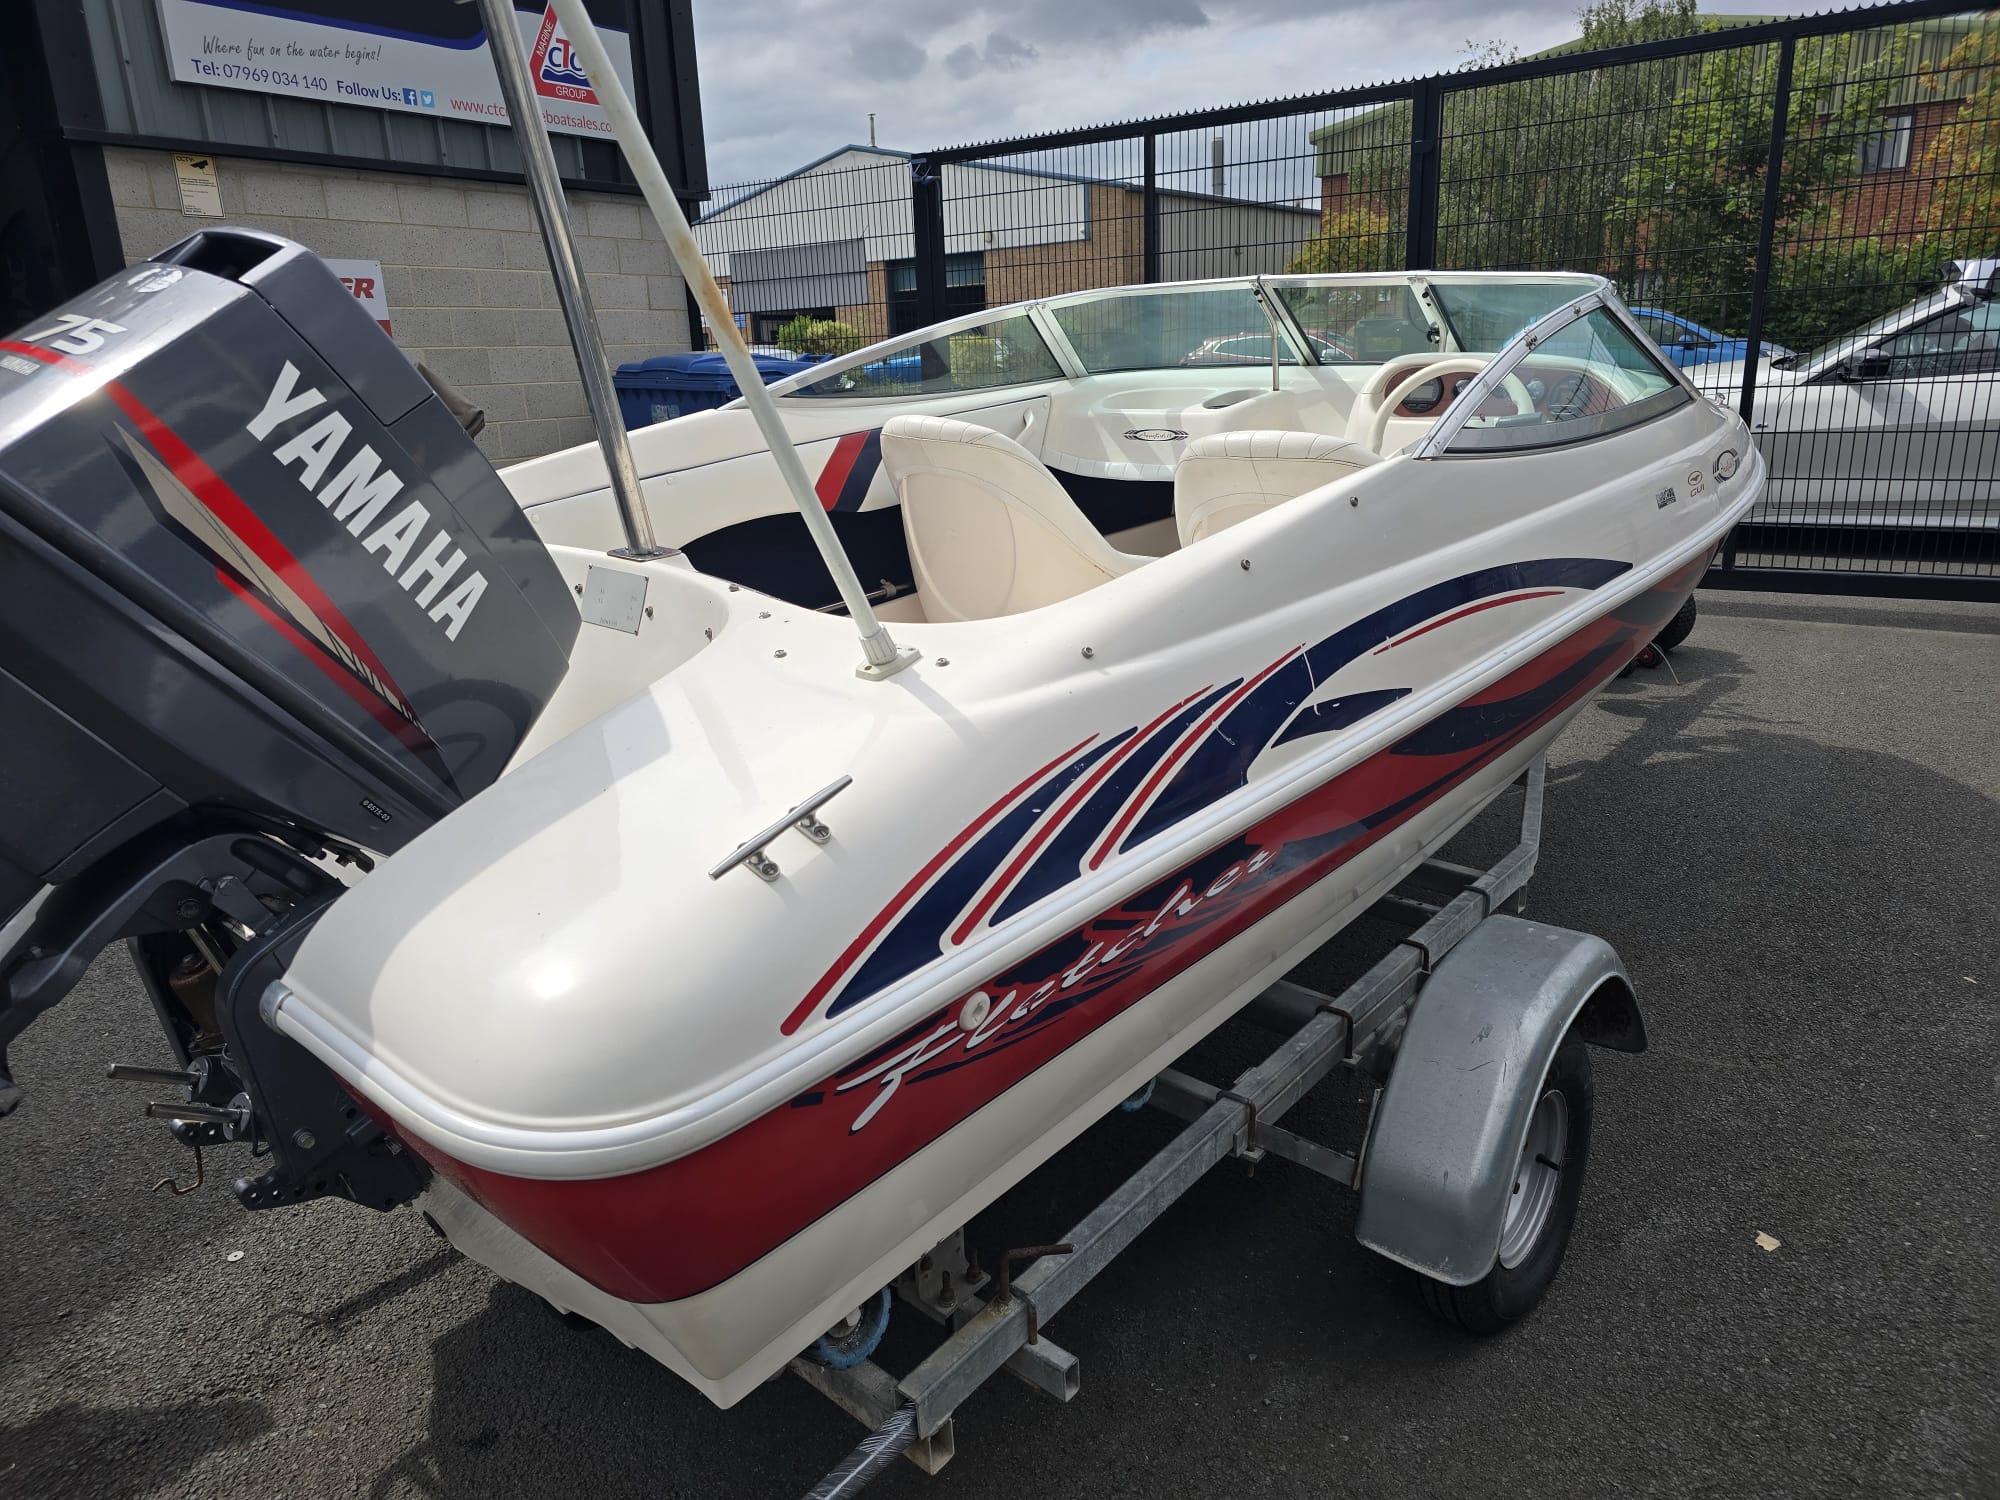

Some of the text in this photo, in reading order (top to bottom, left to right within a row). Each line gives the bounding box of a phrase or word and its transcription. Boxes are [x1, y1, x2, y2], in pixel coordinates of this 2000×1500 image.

[202, 35, 382, 65] Where fun on the water begins!
[536, 19, 554, 57] MARINE
[191, 58, 220, 77] Tel:
[223, 63, 269, 83] 07969
[272, 71, 299, 88] 034
[303, 75, 328, 92] 140
[337, 80, 379, 99] Follow
[381, 86, 401, 102] Us:
[555, 86, 587, 100] GROUP
[22, 313, 128, 355] 75
[246, 360, 489, 642] YAMAHA
